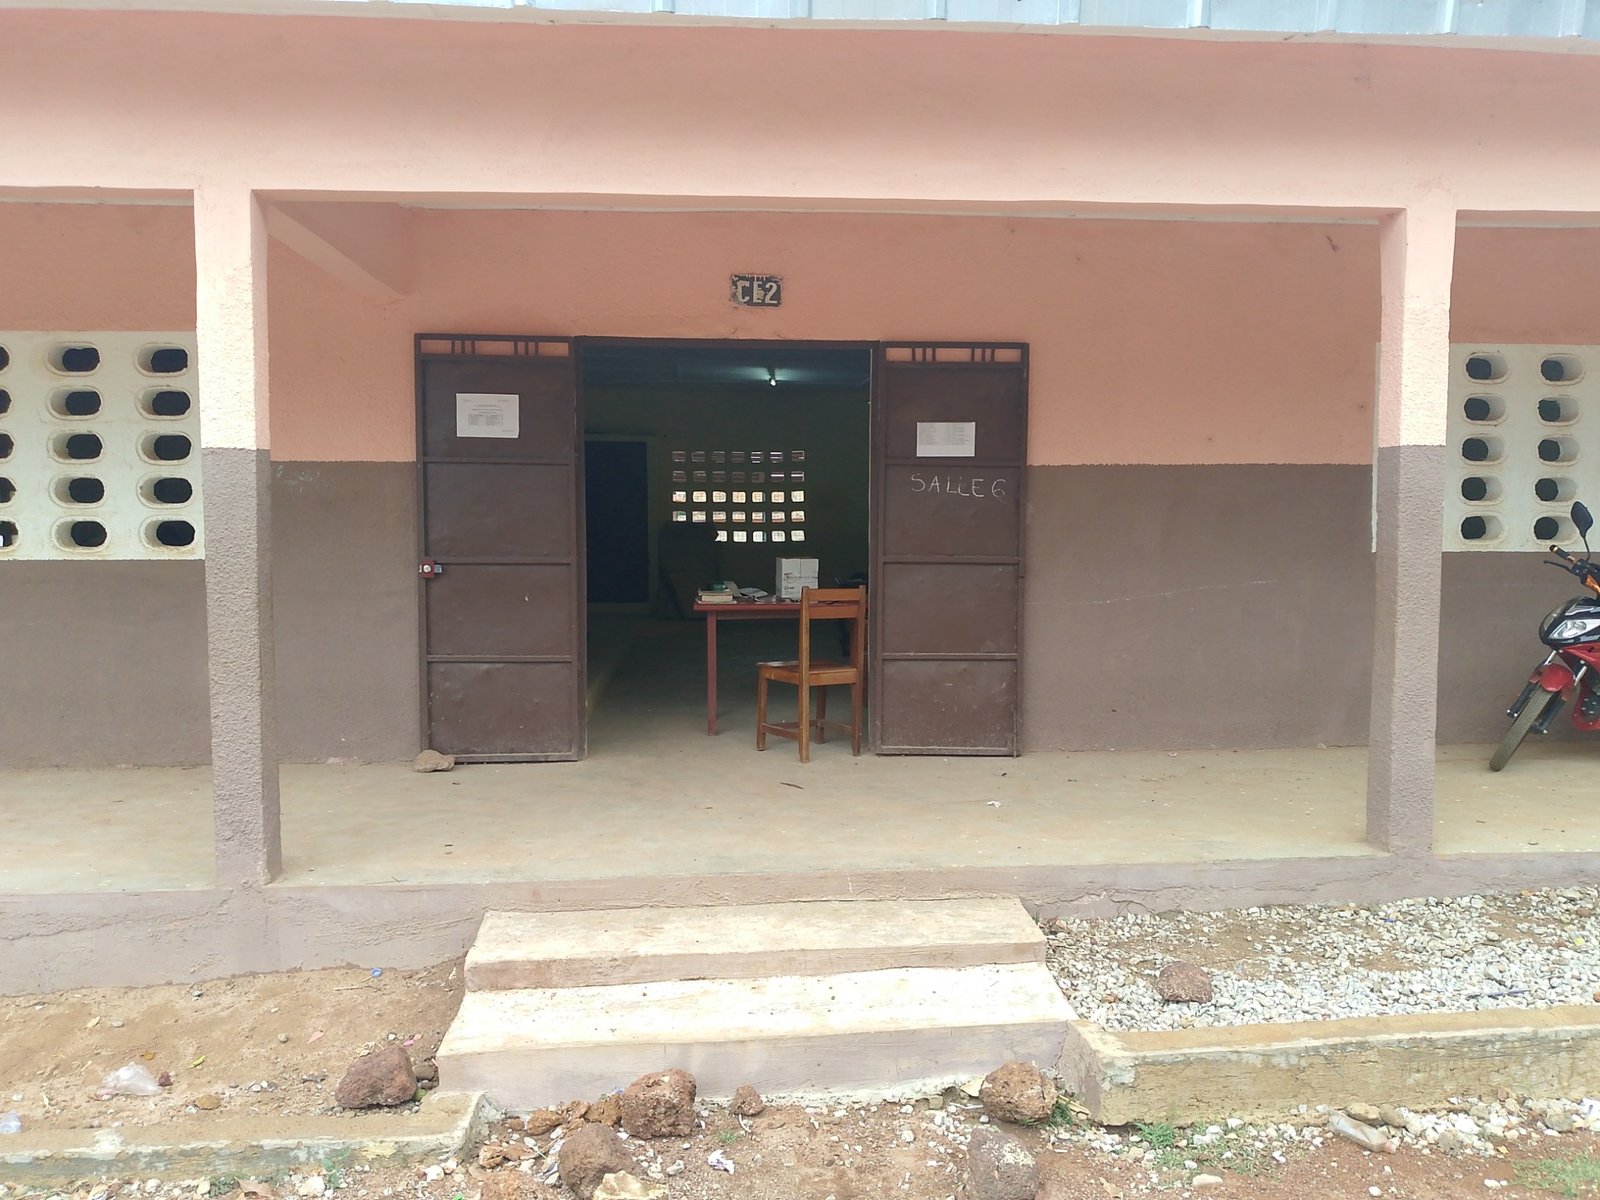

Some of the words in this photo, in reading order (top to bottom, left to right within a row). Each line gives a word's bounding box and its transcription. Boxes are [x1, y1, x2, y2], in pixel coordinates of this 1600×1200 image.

[736, 280, 778, 304] CE2
[911, 473, 985, 498] SALLE
[991, 478, 1007, 498] 6
